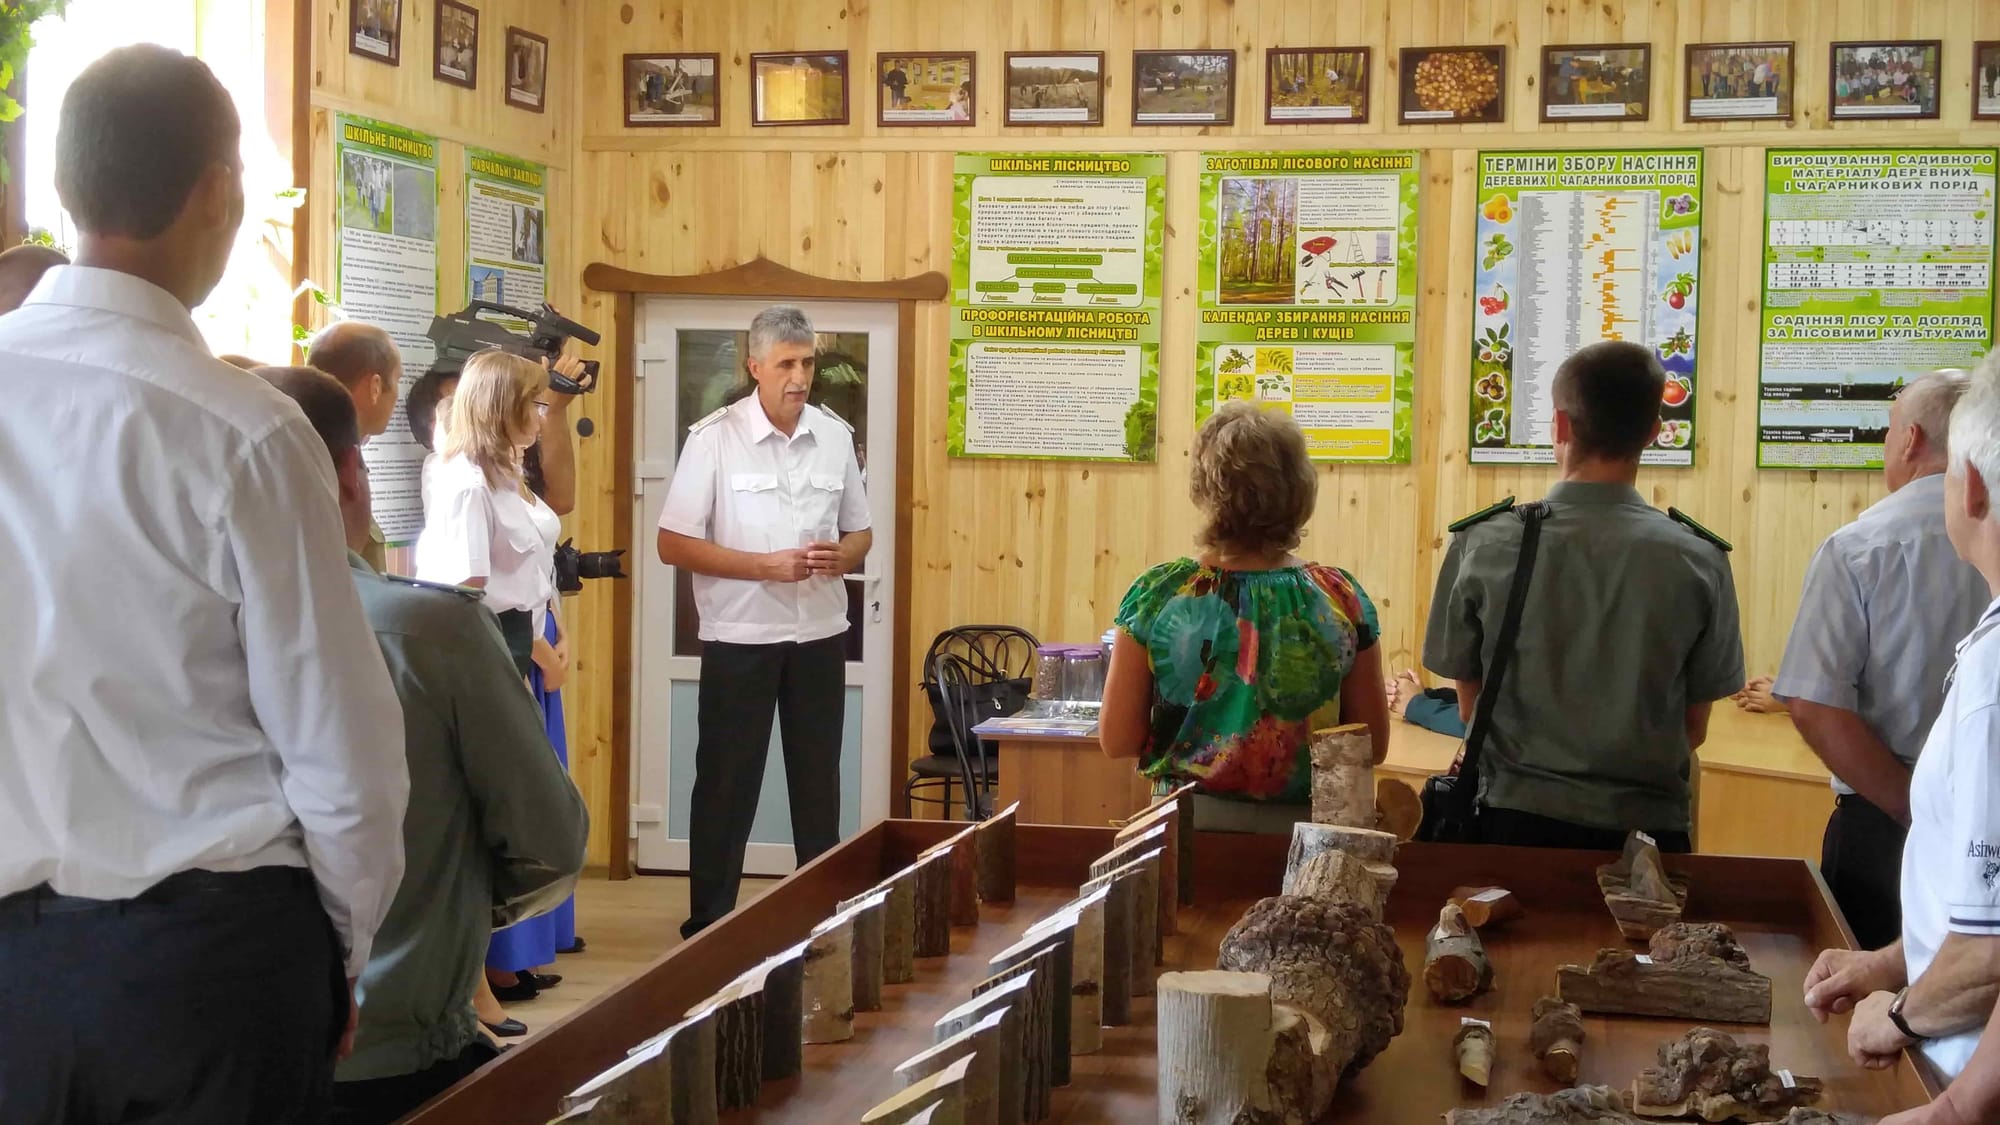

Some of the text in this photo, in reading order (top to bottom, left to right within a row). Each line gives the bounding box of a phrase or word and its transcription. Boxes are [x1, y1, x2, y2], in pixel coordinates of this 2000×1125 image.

[344, 124, 433, 159] ШКІЛЬНЕ ЛІСНИЦТВО
[991, 159, 1130, 173] ШКІЛЬНЕ ЛІСНИЦТВО
[1207, 156, 1412, 170] ЗАГОТІВЛЯ ЛІСОВОГО НАСІННЯ
[1485, 156, 1696, 171] ТЕРМІНИ ЗБОРУ НАСІННЯ
[1773, 156, 1992, 167] ВИРОЩУВАННЯ САДИВНОГО
[471, 156, 542, 187] НАВЧАЛЬНІ ЗАКЛАДИ
[1793, 168, 1972, 178] МАТЕРІАЛУ ДЕРЕВНИХ
[1485, 174, 1696, 187] ДЕРЕВНИХ І ЧАГАРНИКОВИХ ПОРІД
[1785, 181, 1978, 190] І ЧАГАРНИКОВИХ ПОРІД
[961, 309, 1150, 324] ПРОФОРІЄНТАЦІЙНА РОБОТА
[1203, 311, 1409, 325] КАЛЕНДАР ЗБИРАННЯ НАСІННЯ
[1774, 317, 1843, 326] САДІННЯ
[1850, 316, 1886, 325] ЛІСУ
[1918, 316, 1982, 327] ДОГЛЯД
[972, 326, 1138, 340] В ШКІЛЬНОМУ ЛІСНИЦТВІ
[1256, 328, 1354, 341] ДЕРЕВ І КУЩІВ
[1768, 329, 1987, 338] ЗА ЛІСОВИМИ КУЛЬТУРАМИ
